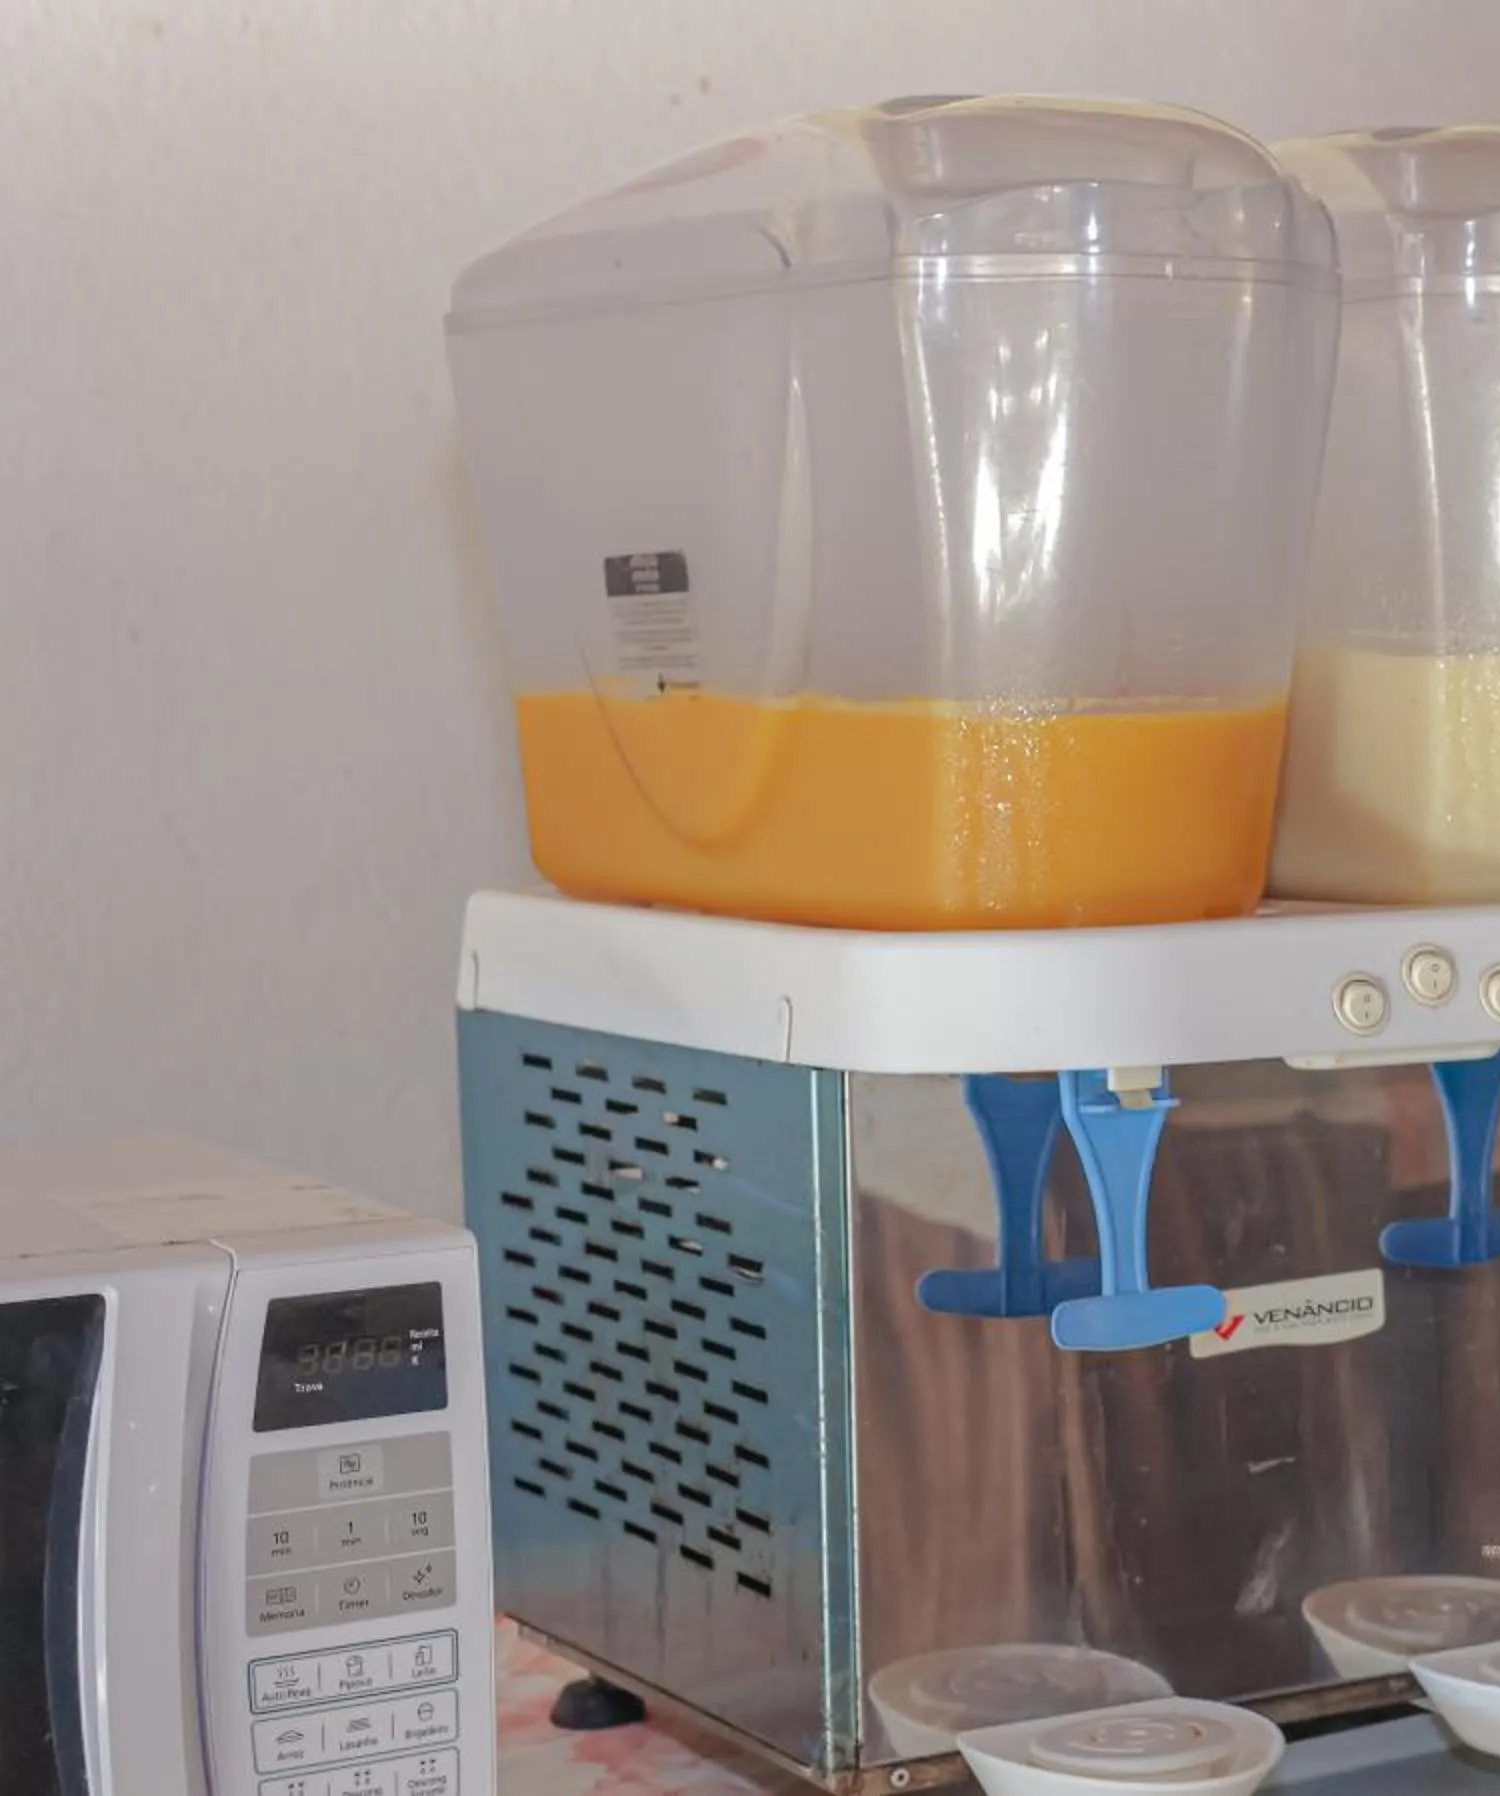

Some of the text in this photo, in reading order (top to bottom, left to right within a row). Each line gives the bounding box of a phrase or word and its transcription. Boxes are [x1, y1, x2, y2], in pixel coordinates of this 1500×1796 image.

[1253, 1296, 1374, 1325] VENÂNCIO
[411, 1511, 427, 1525] 10
[347, 1521, 354, 1534] 1
[272, 1531, 290, 1545] 10
